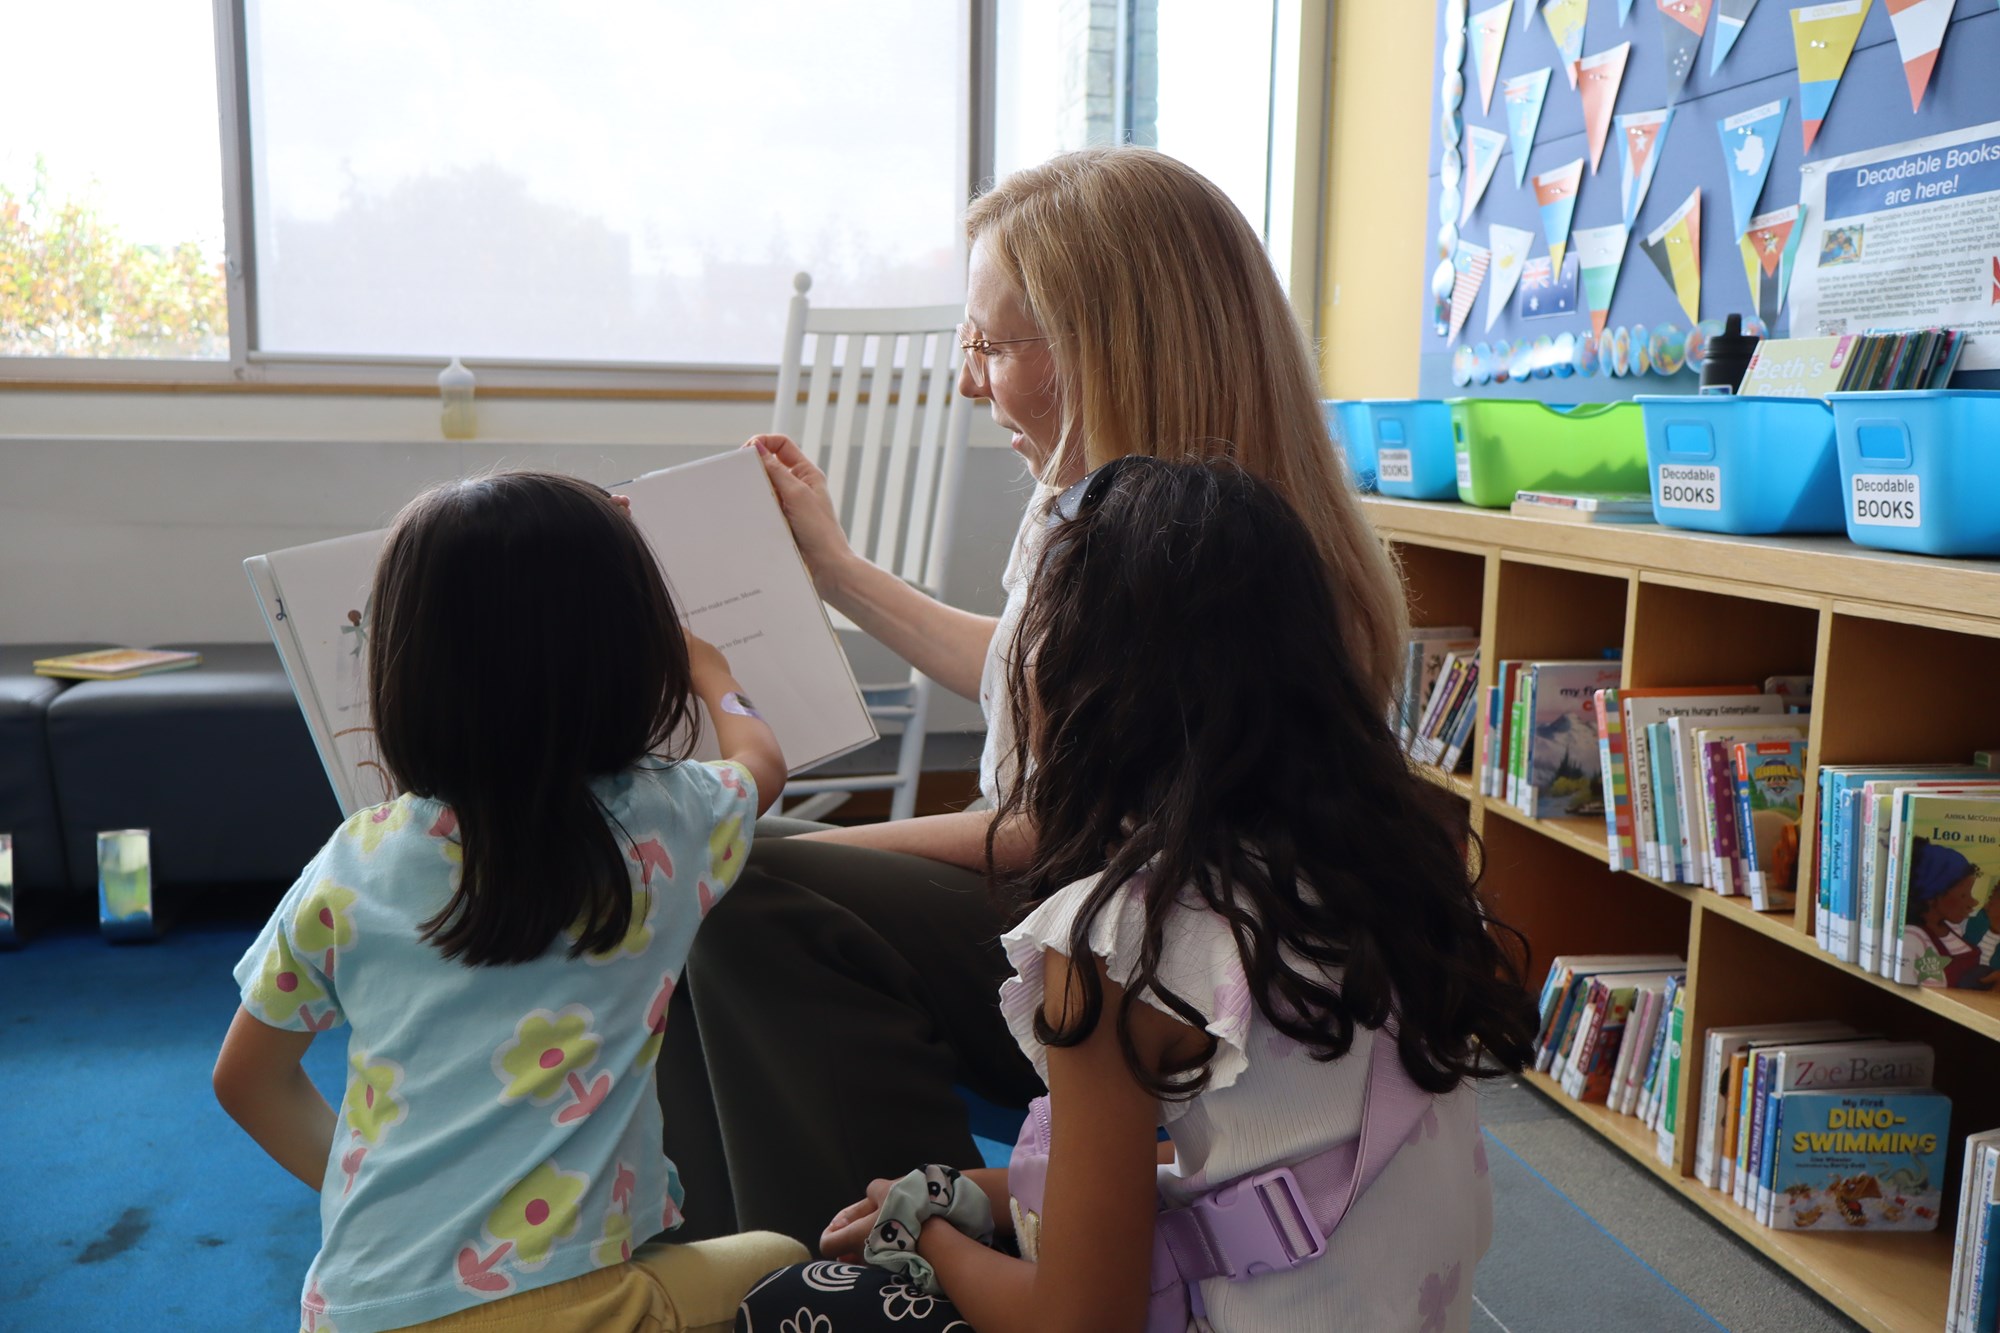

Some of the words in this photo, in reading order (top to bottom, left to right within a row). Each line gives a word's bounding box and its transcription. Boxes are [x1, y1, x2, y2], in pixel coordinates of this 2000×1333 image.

[1857, 155, 1941, 188] Decodable
[1945, 143, 2000, 168] Books
[1885, 187, 1911, 205] are
[1915, 174, 1959, 200] here!
[1753, 357, 1825, 380] Beth's
[1662, 468, 1715, 481] Decodable
[1663, 486, 1715, 503] BOOKS
[1856, 478, 1915, 493] Decodable
[1857, 500, 1914, 519] BOOKS
[1560, 687, 1579, 697] my
[1658, 707, 1671, 716] The
[1673, 707, 1689, 717] Very
[1691, 706, 1719, 716] Hungry
[1720, 705, 1760, 715] Caterpillar
[1635, 736, 1646, 777] LITTLE
[1639, 783, 1649, 813] DUCK
[1932, 827, 1961, 842] Leo
[1965, 834, 1974, 842] at
[1979, 834, 1996, 844] the
[1794, 1060, 1842, 1087] Zoe
[1849, 1057, 1925, 1083] Beans
[1842, 1098, 1856, 1108] My
[1859, 1098, 1884, 1107] First
[1827, 1107, 1907, 1130] DINO-
[1792, 1131, 1937, 1154] SWIMMING
